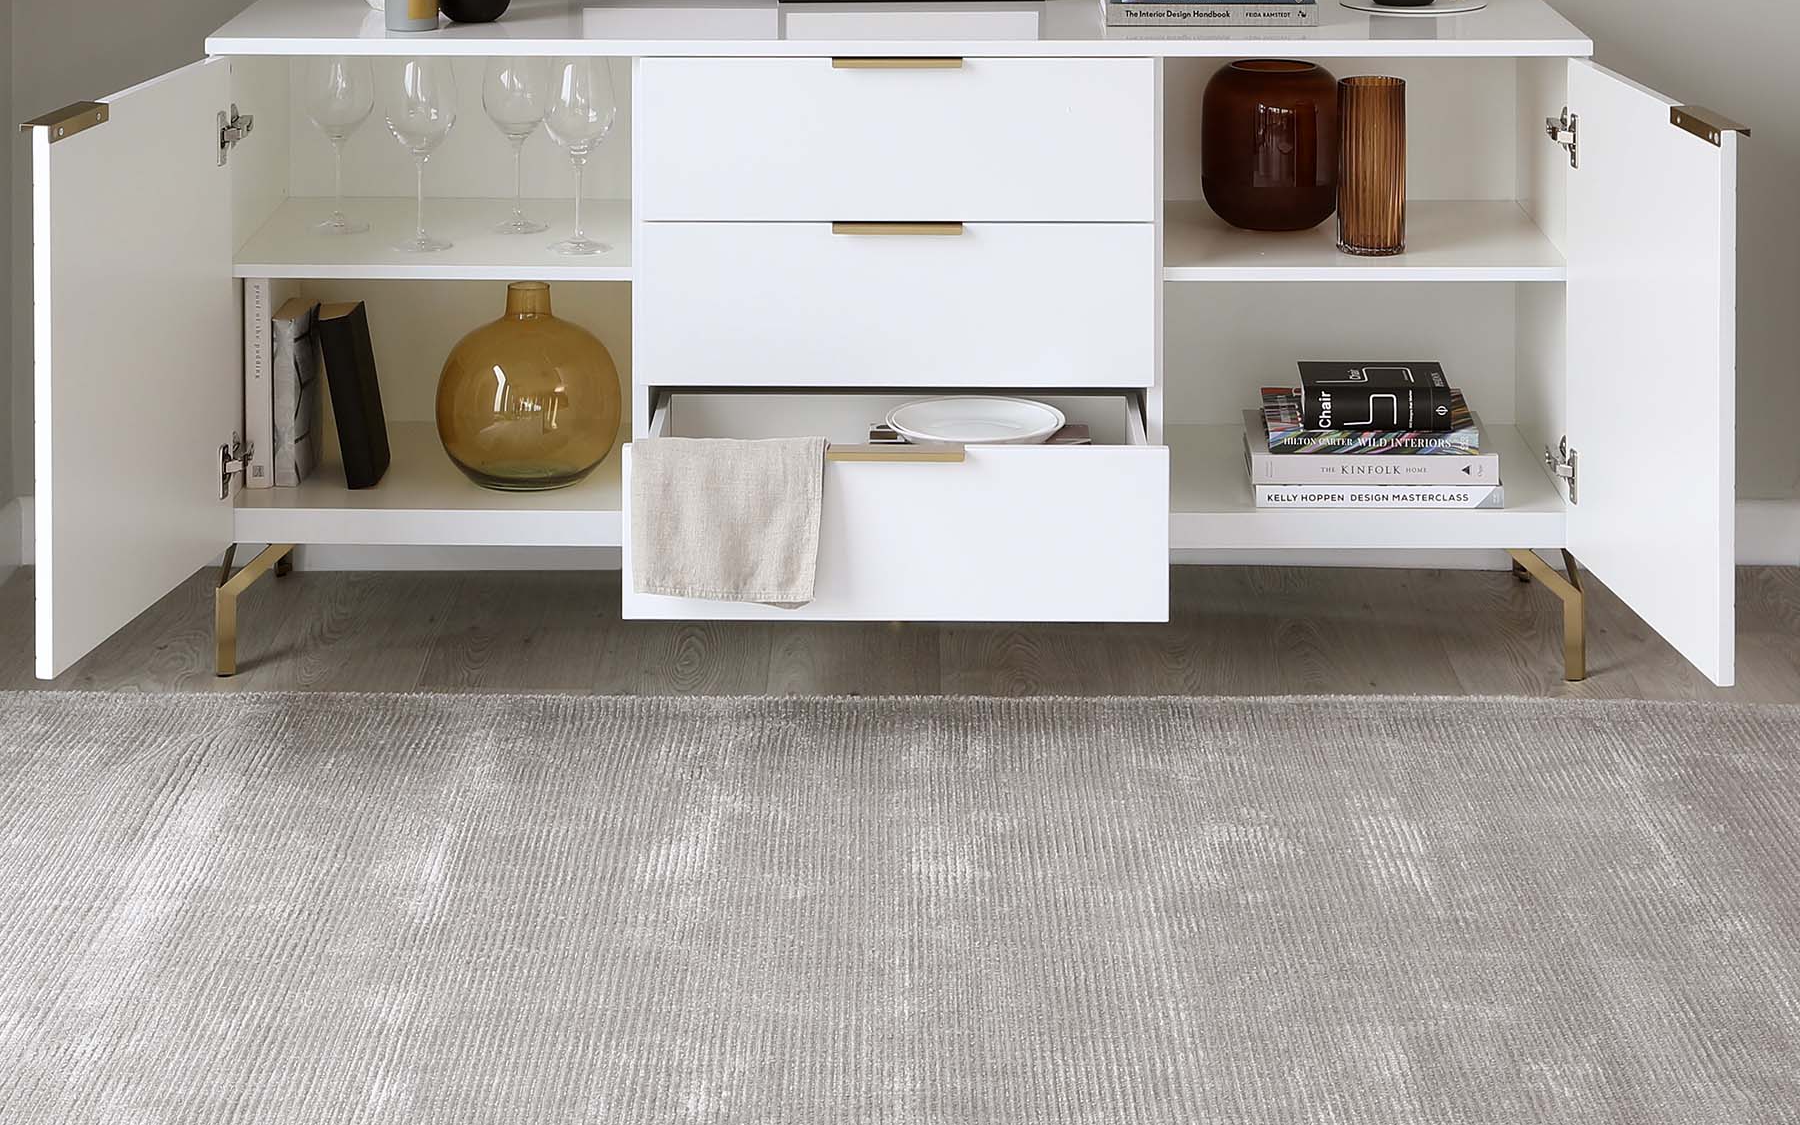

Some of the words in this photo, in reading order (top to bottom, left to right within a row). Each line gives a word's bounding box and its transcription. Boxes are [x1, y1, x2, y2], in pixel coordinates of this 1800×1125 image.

[1125, 10, 1138, 18] The
[1139, 10, 1165, 18] Interior
[1166, 10, 1192, 20] Design
[1193, 10, 1231, 18] Handbook
[1318, 390, 1332, 428] Chair
[1283, 437, 1317, 446] HILTON
[1318, 437, 1353, 446] CARTER
[1357, 438, 1388, 448] WILD
[1390, 438, 1452, 449] INTERIORS
[1341, 465, 1401, 475] KINFOLK
[1267, 494, 1298, 502] KELLY
[1301, 494, 1345, 502] HOPPEN
[1350, 494, 1389, 502] DESIGN
[1392, 494, 1469, 502] MASTERCLASS
